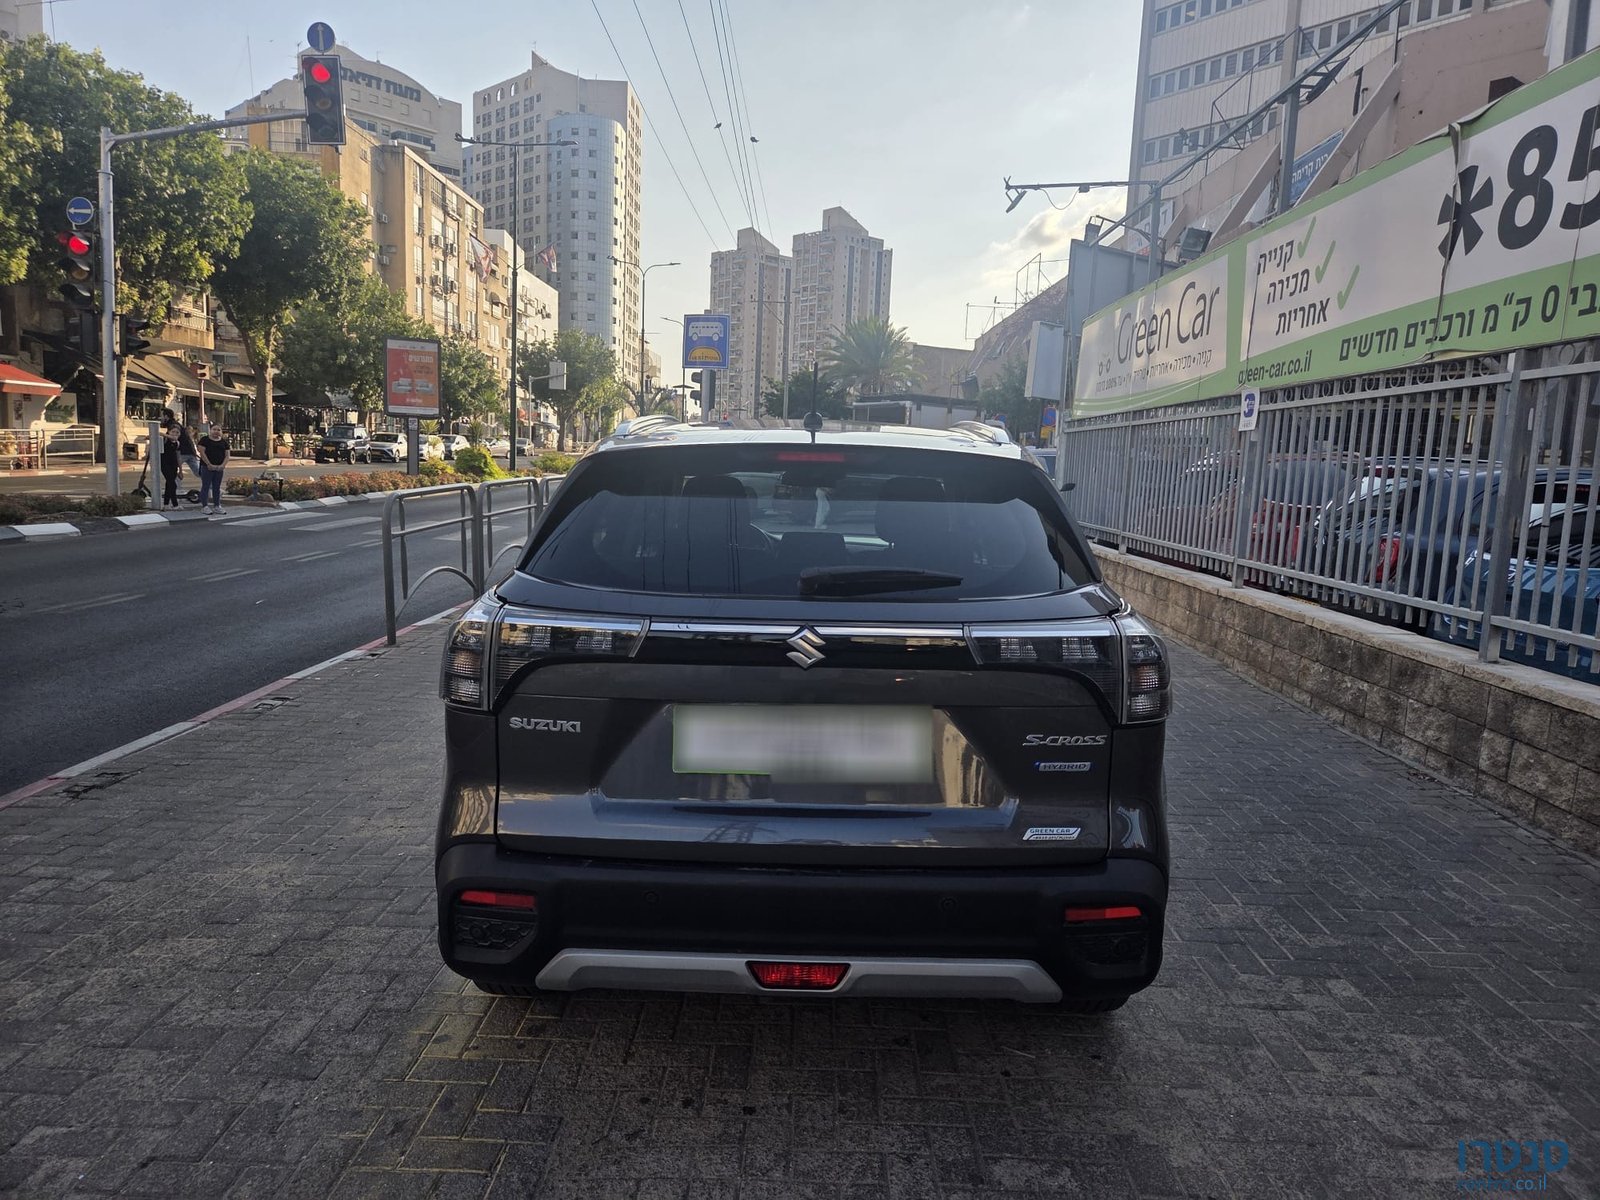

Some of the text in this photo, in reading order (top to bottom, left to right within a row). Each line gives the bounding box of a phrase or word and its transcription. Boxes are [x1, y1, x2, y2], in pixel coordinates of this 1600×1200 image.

[1257, 240, 1295, 276] קנייה
[1267, 268, 1310, 304] מכירה
[1117, 281, 1221, 364] Green Car
[1275, 298, 1330, 336] אחריות
[1403, 308, 1476, 350] ורכבים
[1339, 326, 1399, 362] חדשים
[509, 716, 581, 733] SUZUKI
[1042, 763, 1087, 771] HYBRID
